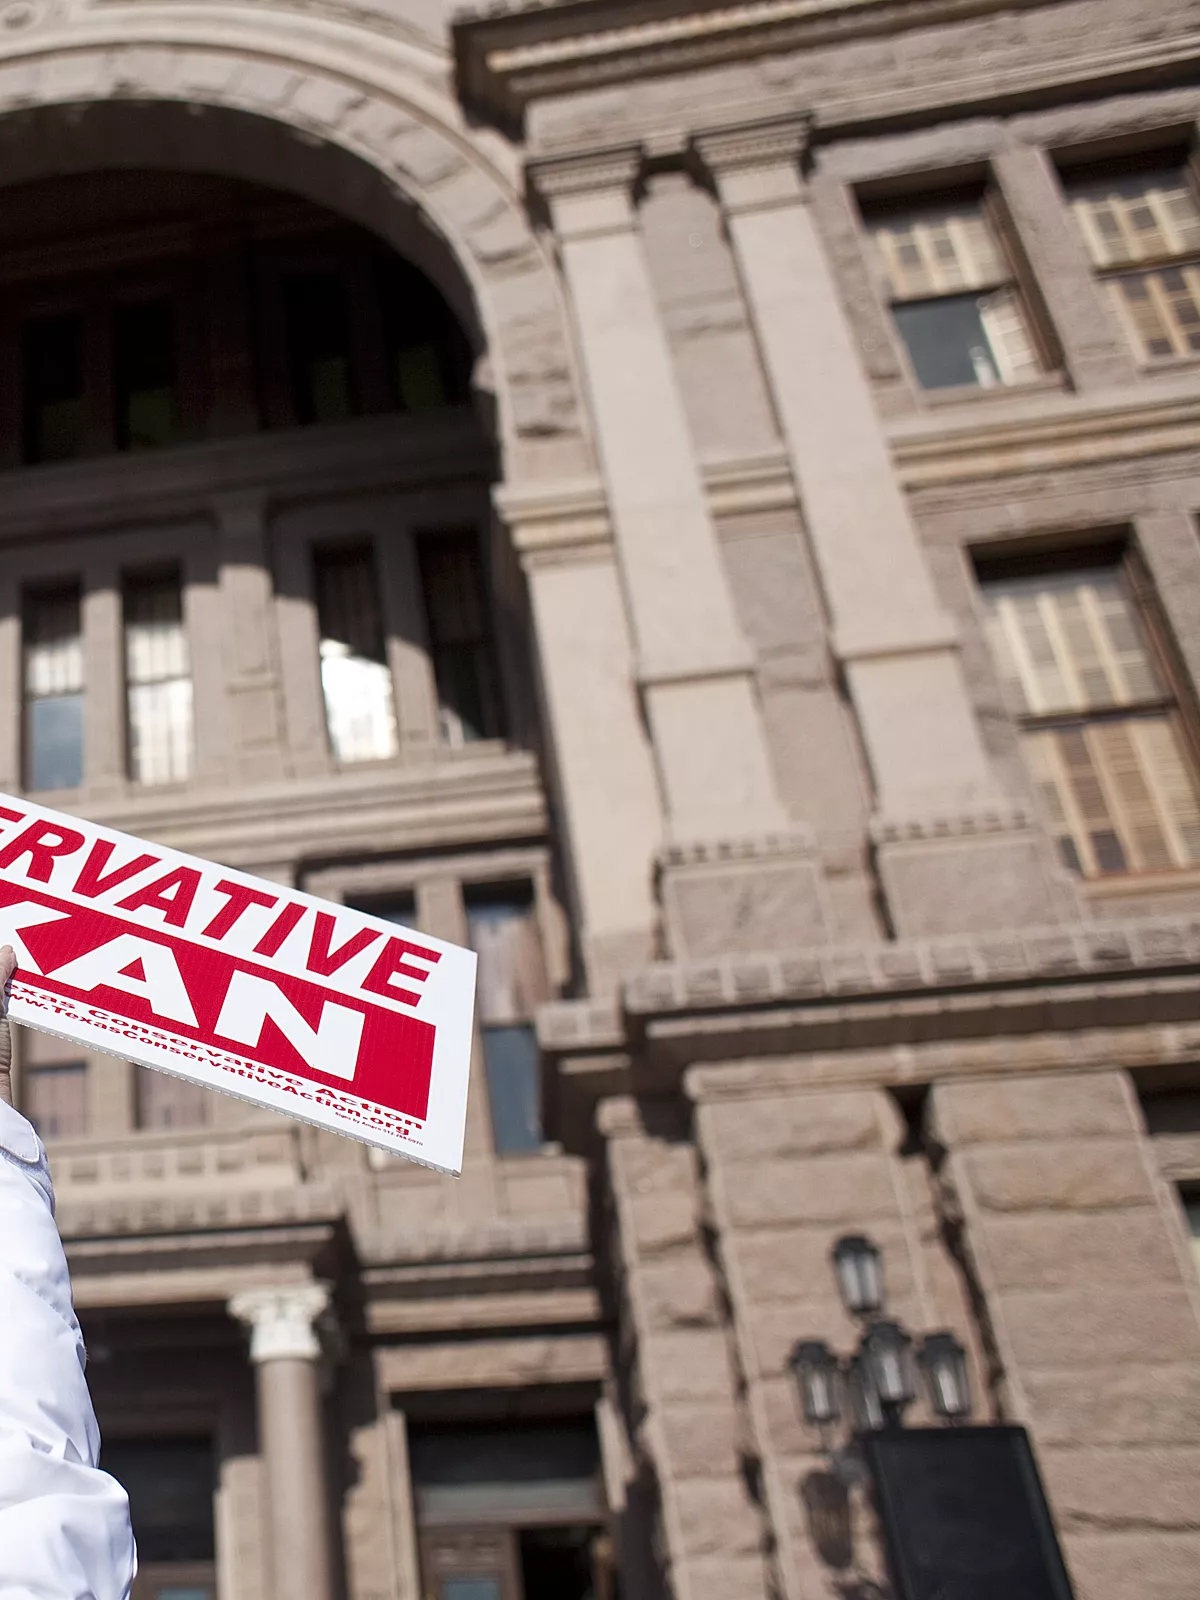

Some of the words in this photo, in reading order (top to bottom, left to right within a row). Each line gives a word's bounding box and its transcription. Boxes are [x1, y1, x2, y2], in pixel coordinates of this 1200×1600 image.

[6, 992, 410, 1136] ww.TexasConservativeAction.org
[10, 984, 76, 1010] exas
[87, 1008, 304, 1087] Conservative
[314, 1088, 423, 1130] Action
